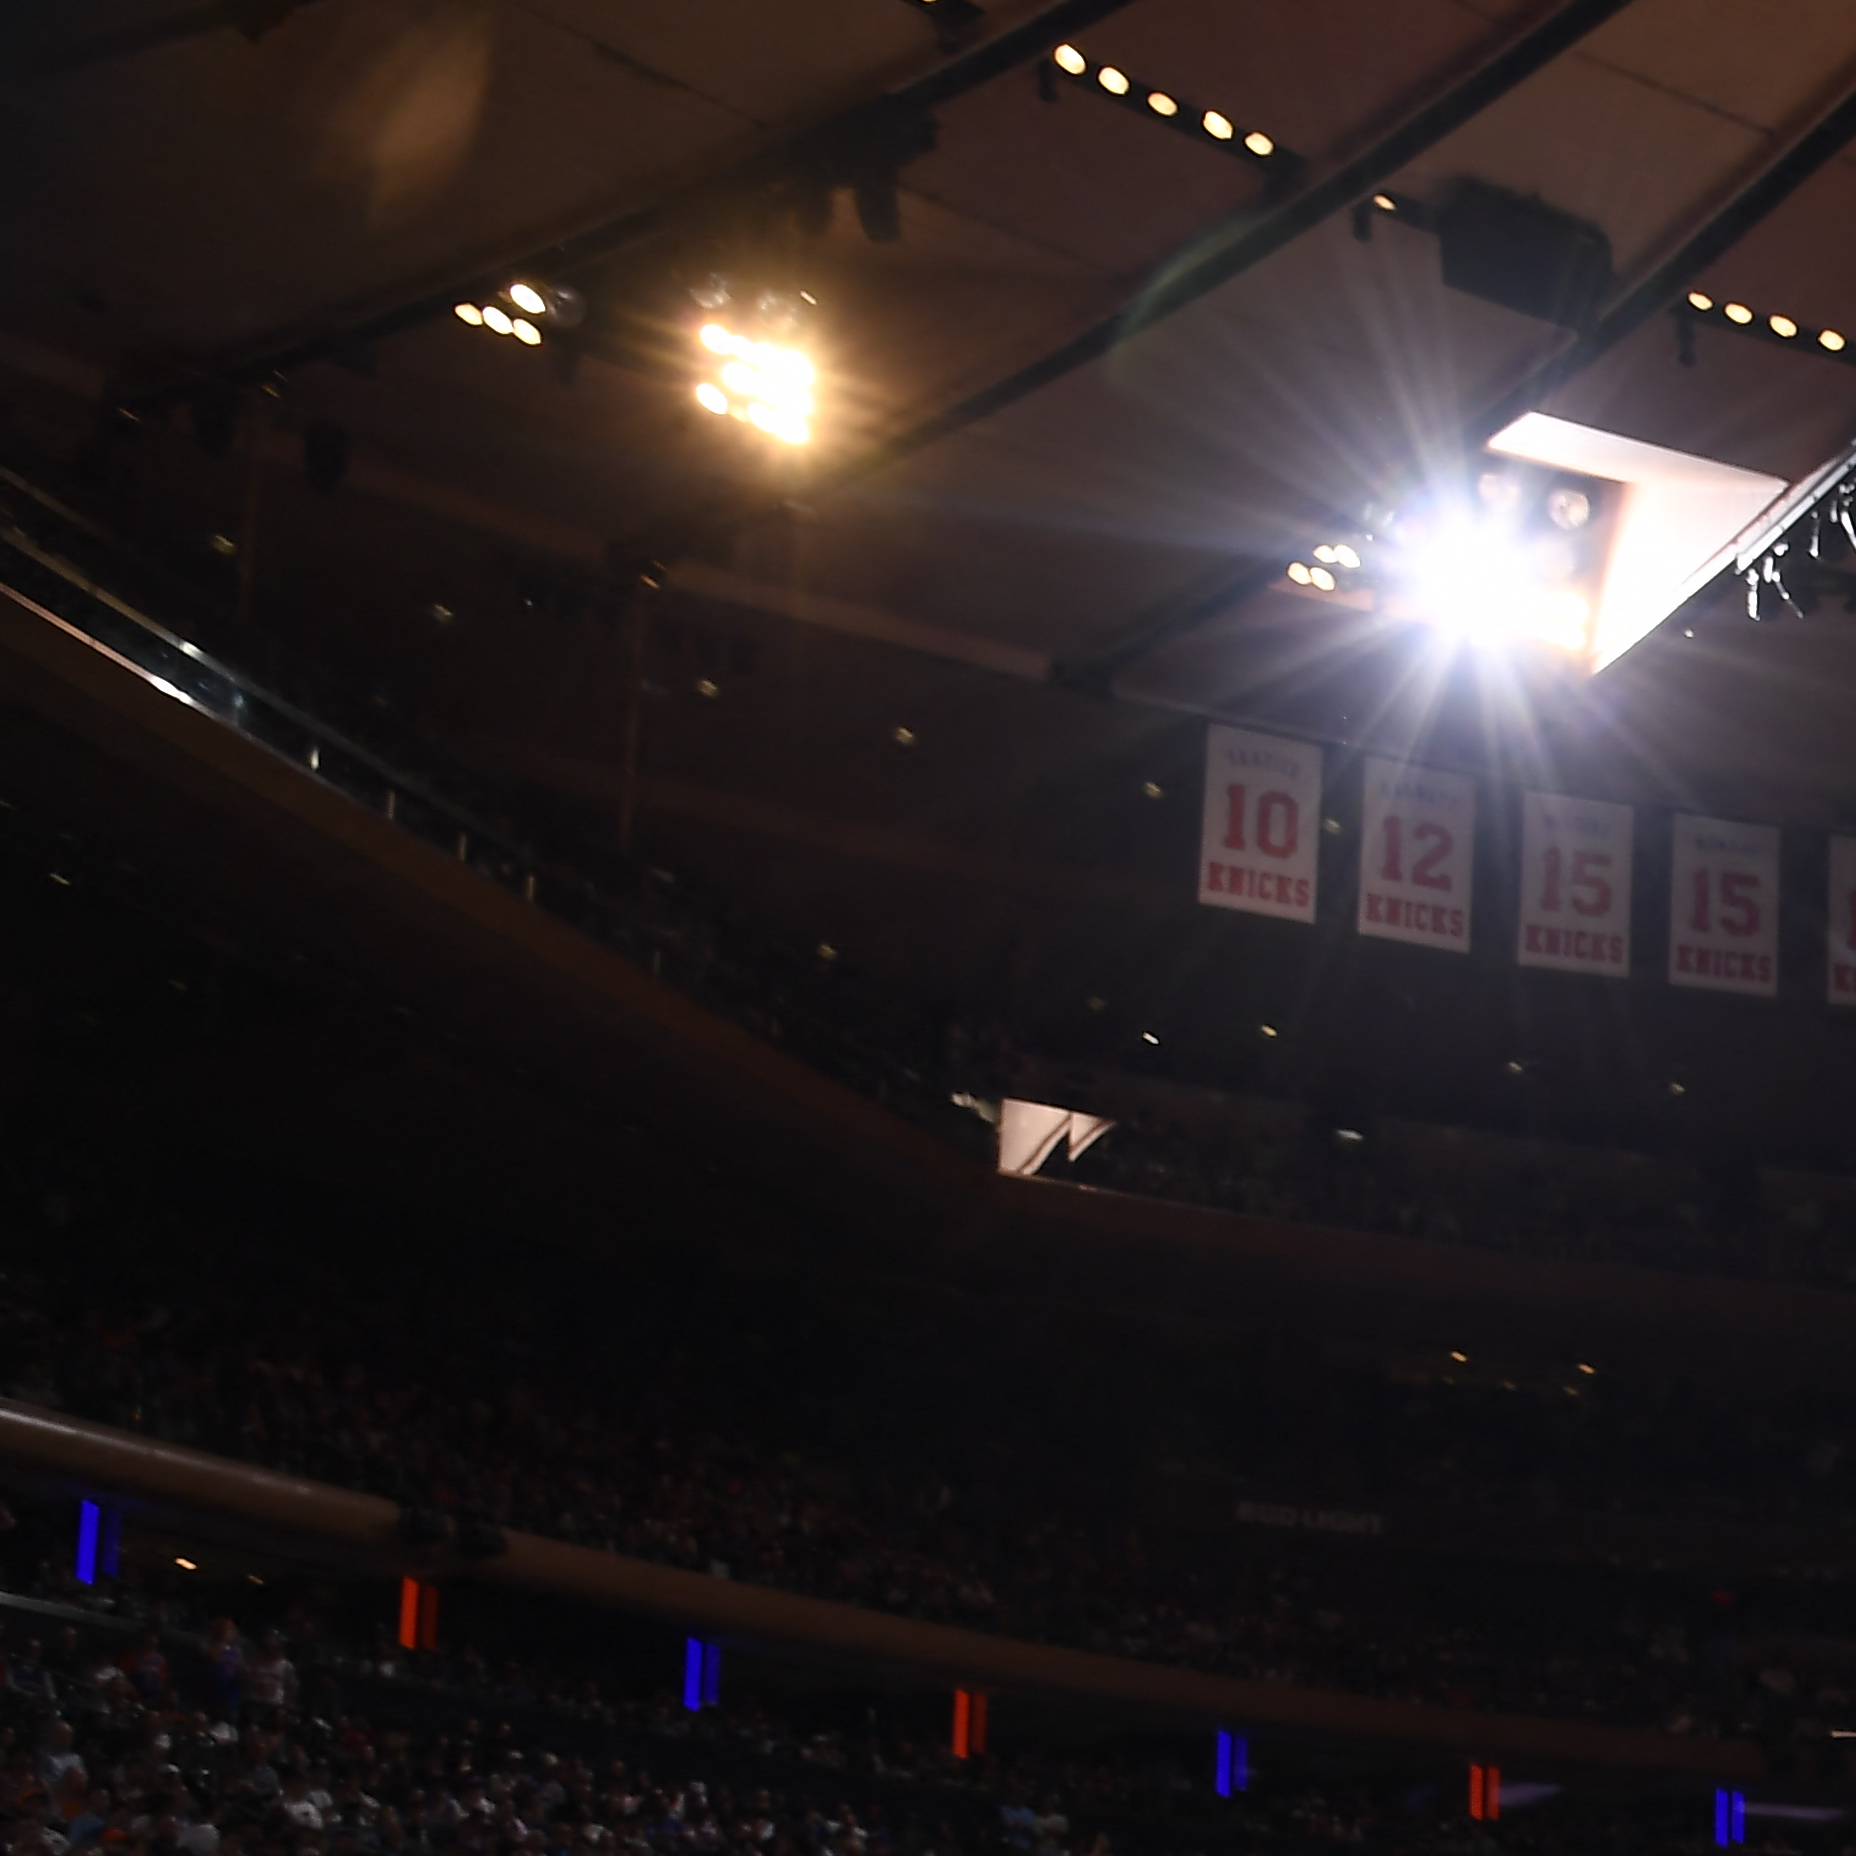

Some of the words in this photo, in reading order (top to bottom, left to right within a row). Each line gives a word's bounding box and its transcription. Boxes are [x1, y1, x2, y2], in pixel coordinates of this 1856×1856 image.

[1223, 783, 1300, 859] 10
[1381, 815, 1455, 892] 12
[1539, 846, 1613, 918] 15
[1207, 861, 1310, 908] KNICKS
[1690, 867, 1760, 938] 15
[1366, 893, 1464, 938] KNICKS
[1524, 923, 1624, 964] KNICKS
[1676, 943, 1772, 983] KNICKS
